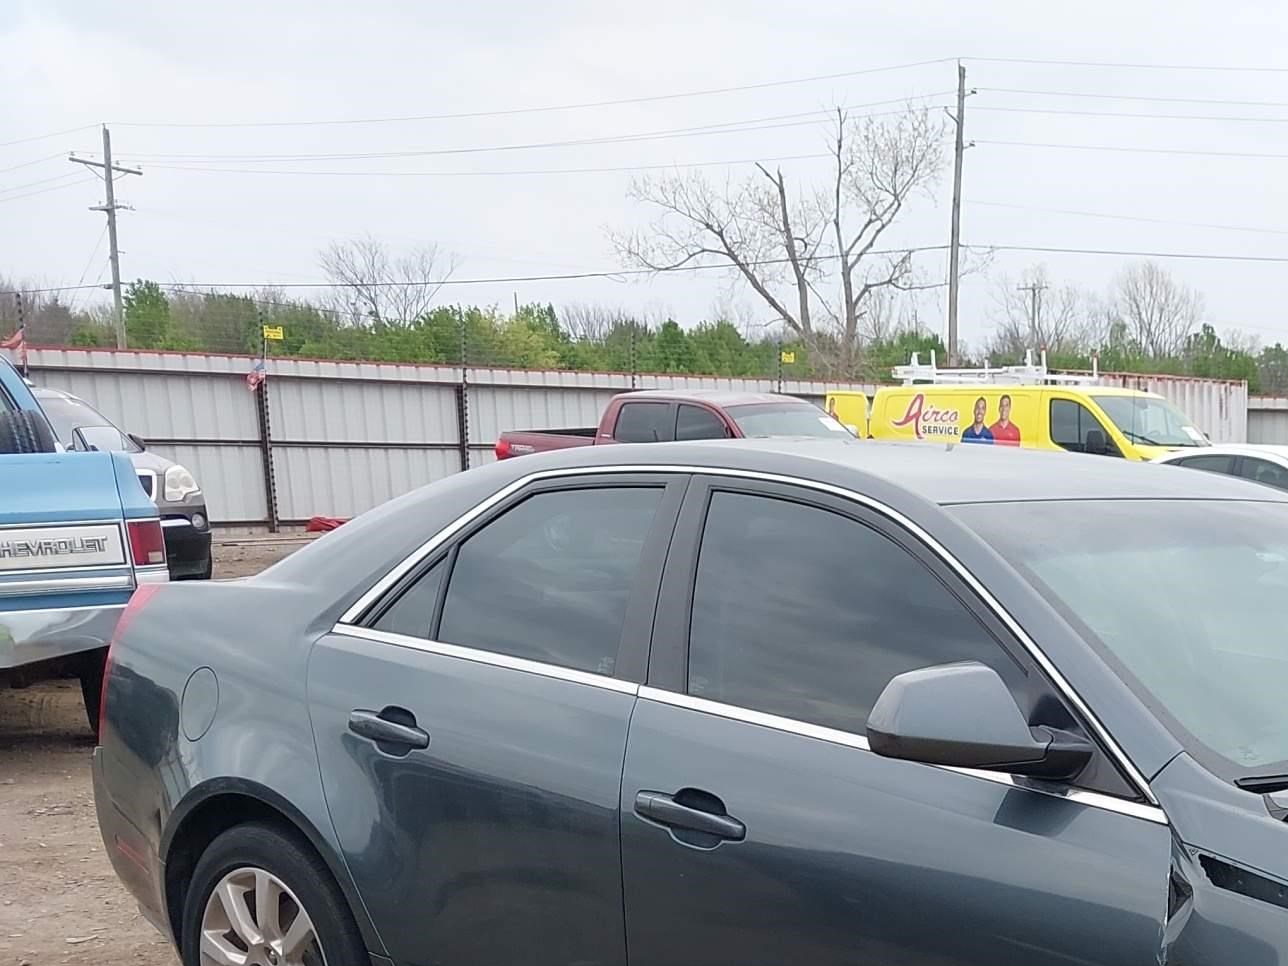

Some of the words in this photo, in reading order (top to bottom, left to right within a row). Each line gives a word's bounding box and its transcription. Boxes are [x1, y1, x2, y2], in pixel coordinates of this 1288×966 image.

[892, 393, 959, 440] Airco
[922, 425, 959, 436] SERVICE
[0, 536, 108, 558] HEVROLET
